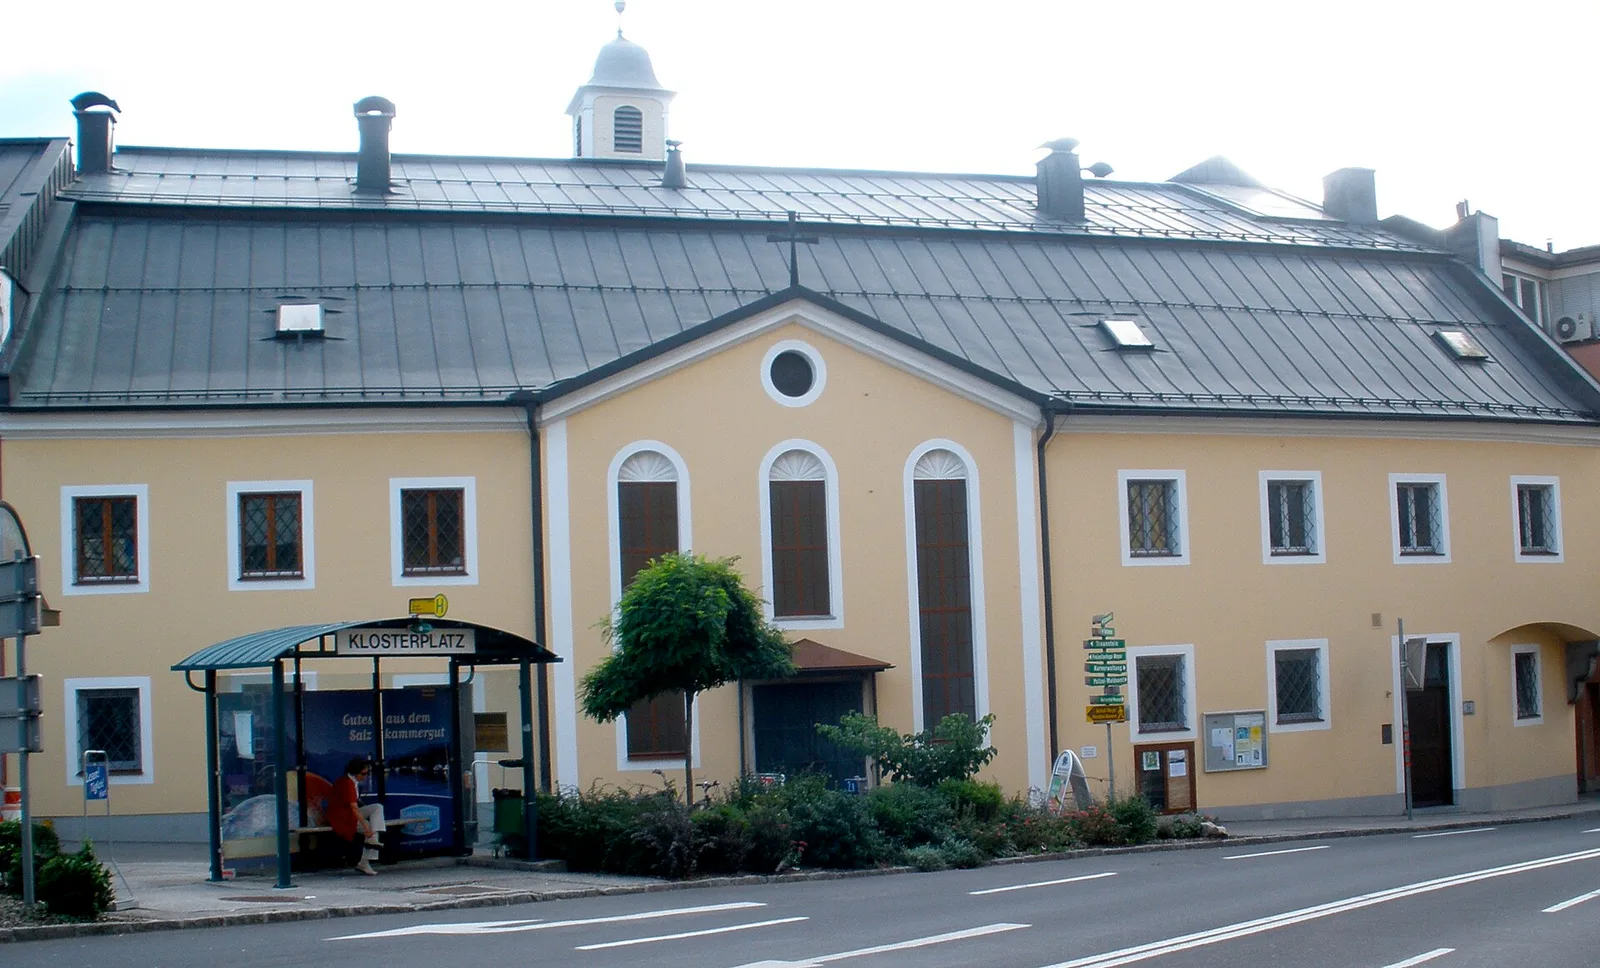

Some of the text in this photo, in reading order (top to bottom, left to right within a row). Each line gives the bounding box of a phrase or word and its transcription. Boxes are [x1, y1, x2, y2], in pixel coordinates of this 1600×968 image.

[436, 598, 444, 613] H
[348, 633, 465, 649] KLOSTERPLATZ
[342, 712, 431, 726] Gutes aus dem
[349, 727, 446, 741] Salz kammergut
